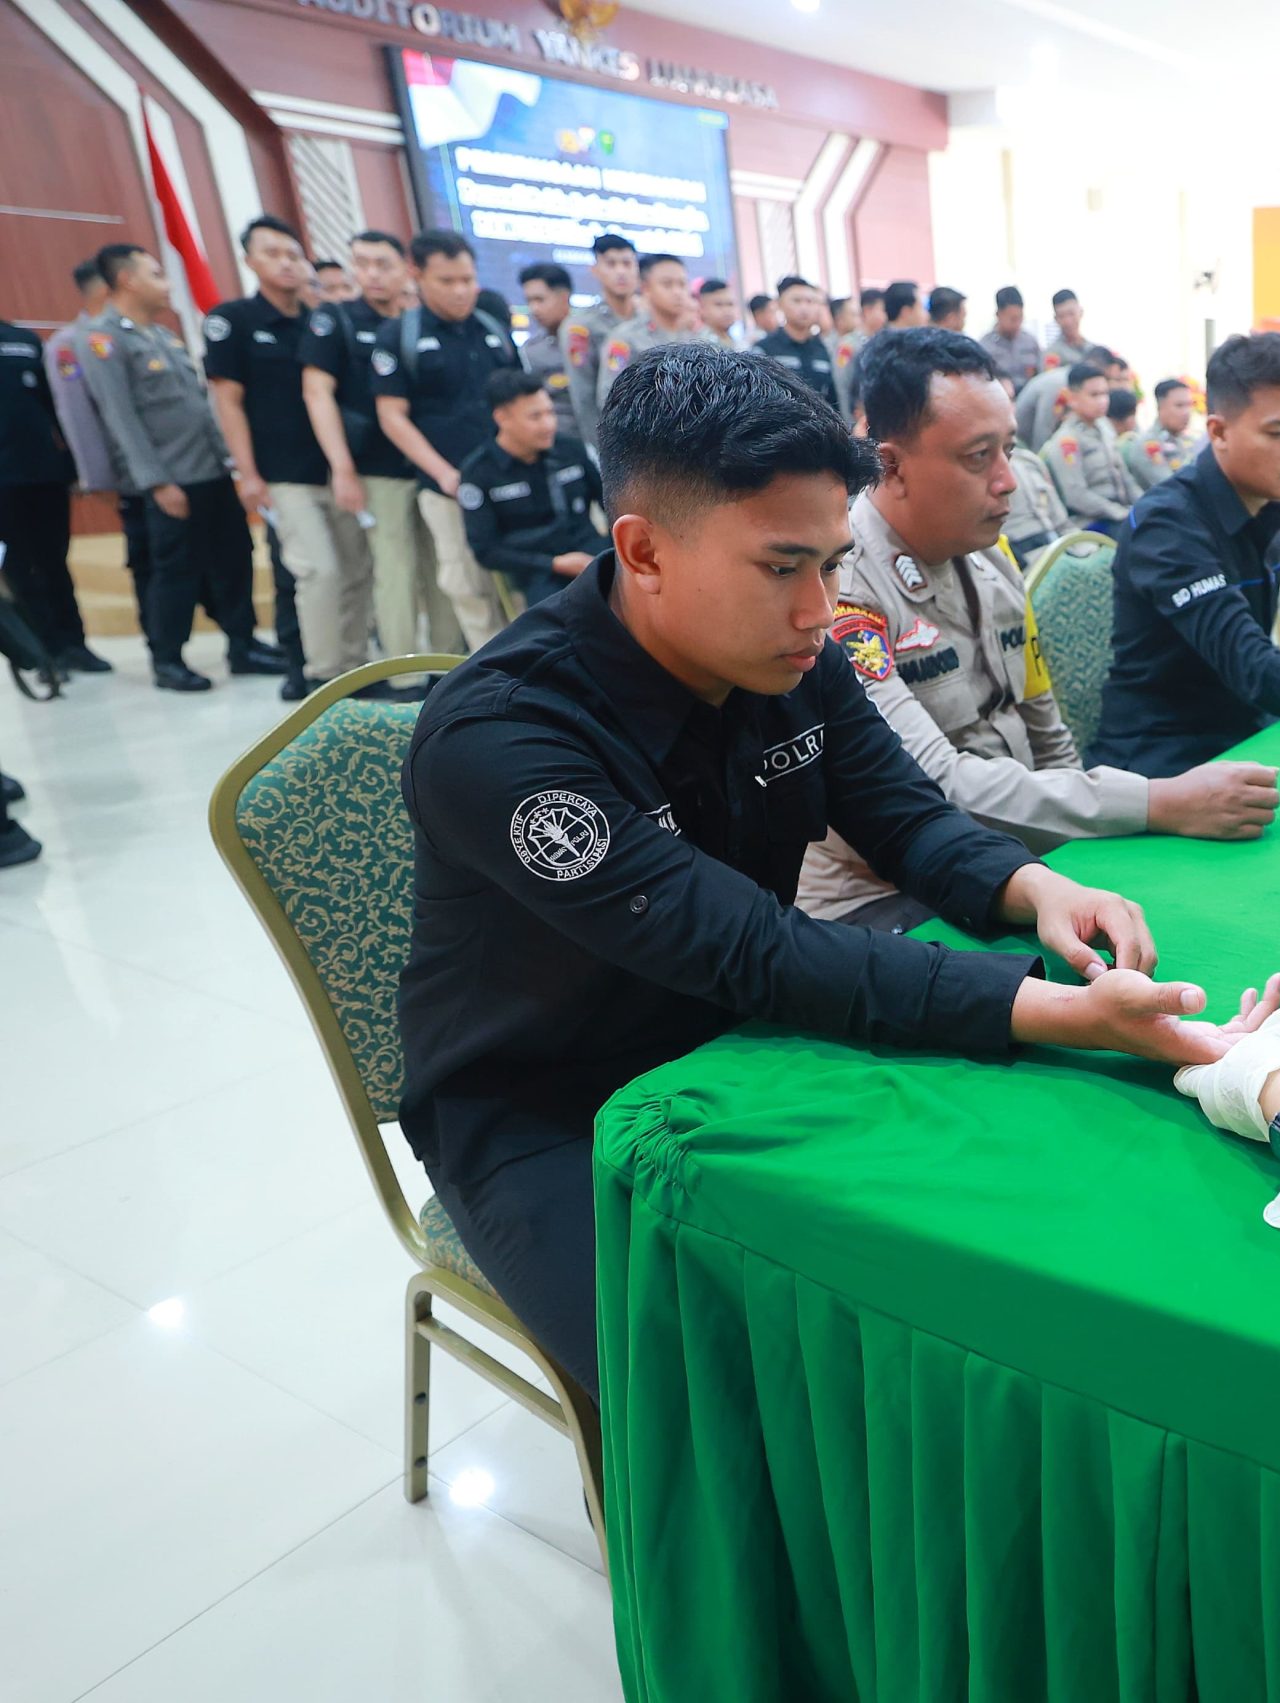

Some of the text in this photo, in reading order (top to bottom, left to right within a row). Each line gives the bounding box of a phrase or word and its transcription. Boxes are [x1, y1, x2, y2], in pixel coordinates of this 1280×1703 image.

[297, 0, 518, 50] DITORIUM
[1189, 573, 1227, 598] HUMAS
[763, 730, 824, 770] OLRI
[537, 792, 598, 818] DIPERCAYA
[513, 813, 531, 864] OBYEKTIF
[571, 830, 590, 846] POLRI
[556, 838, 608, 879] PARTISIPASI
